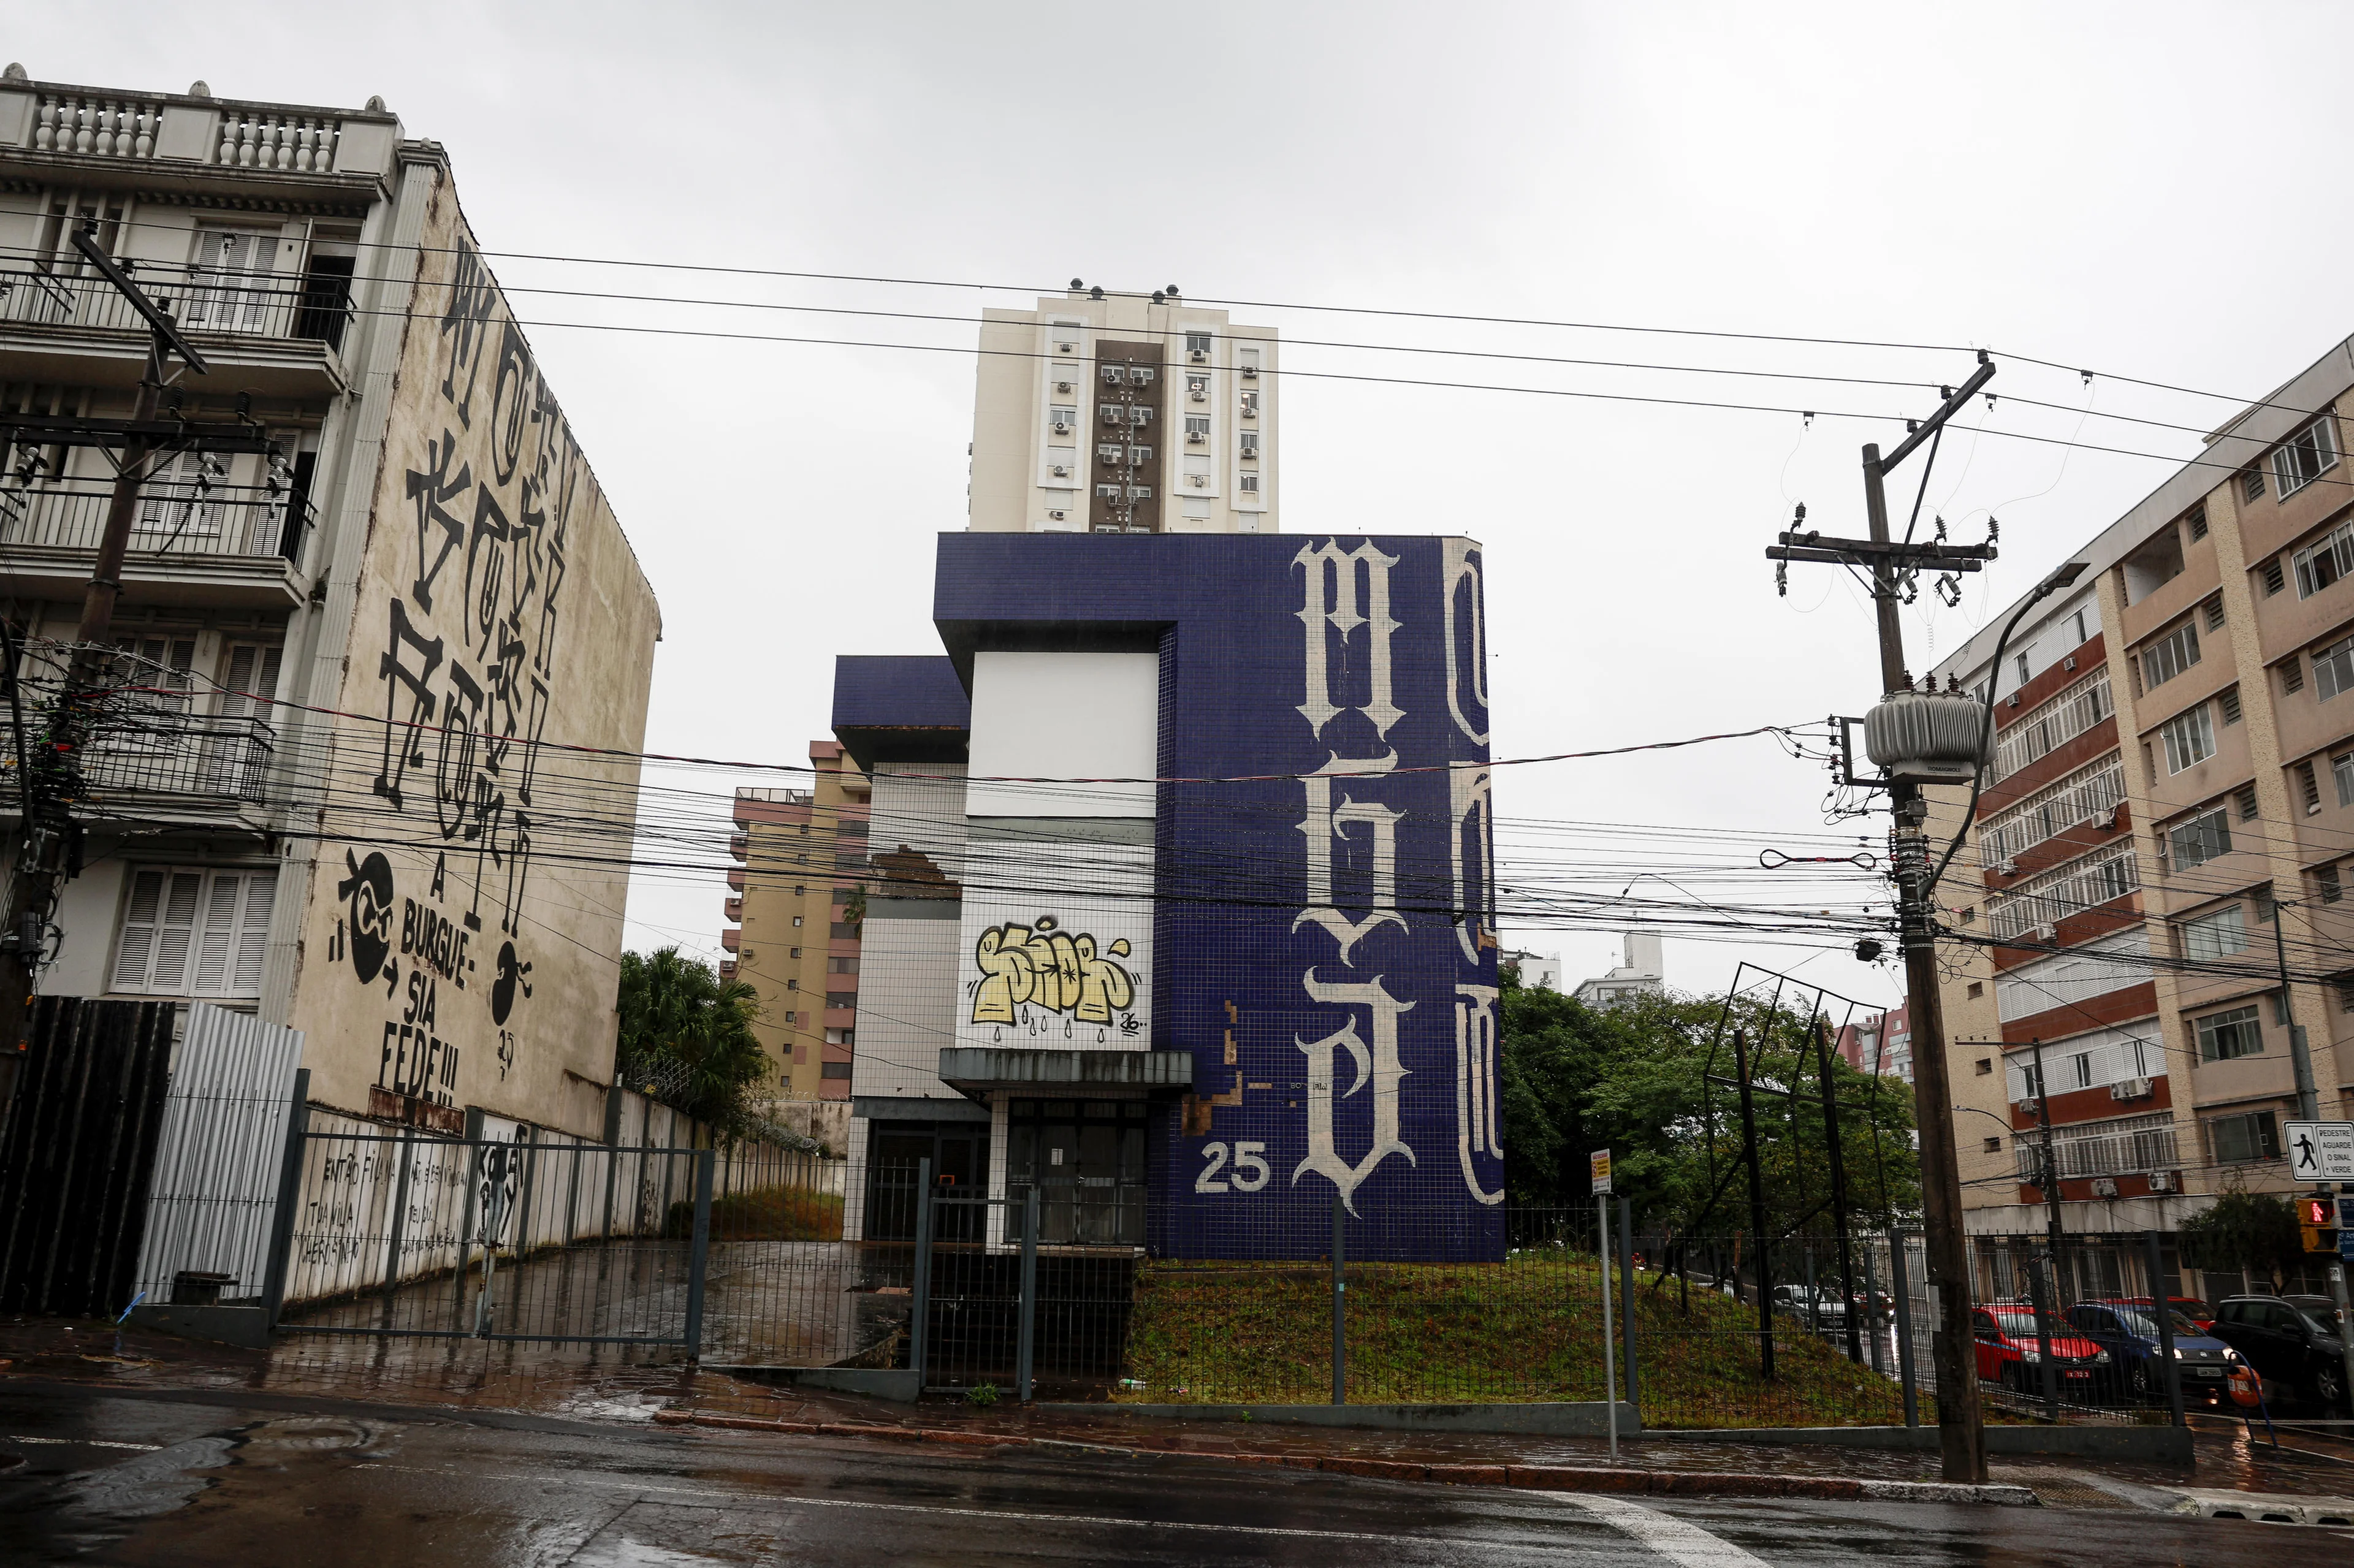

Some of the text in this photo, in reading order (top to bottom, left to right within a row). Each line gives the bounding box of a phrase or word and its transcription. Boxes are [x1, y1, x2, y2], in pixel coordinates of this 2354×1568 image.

[430, 850, 444, 904] A
[404, 970, 435, 1033] SIA
[1194, 1141, 1272, 1194] 25
